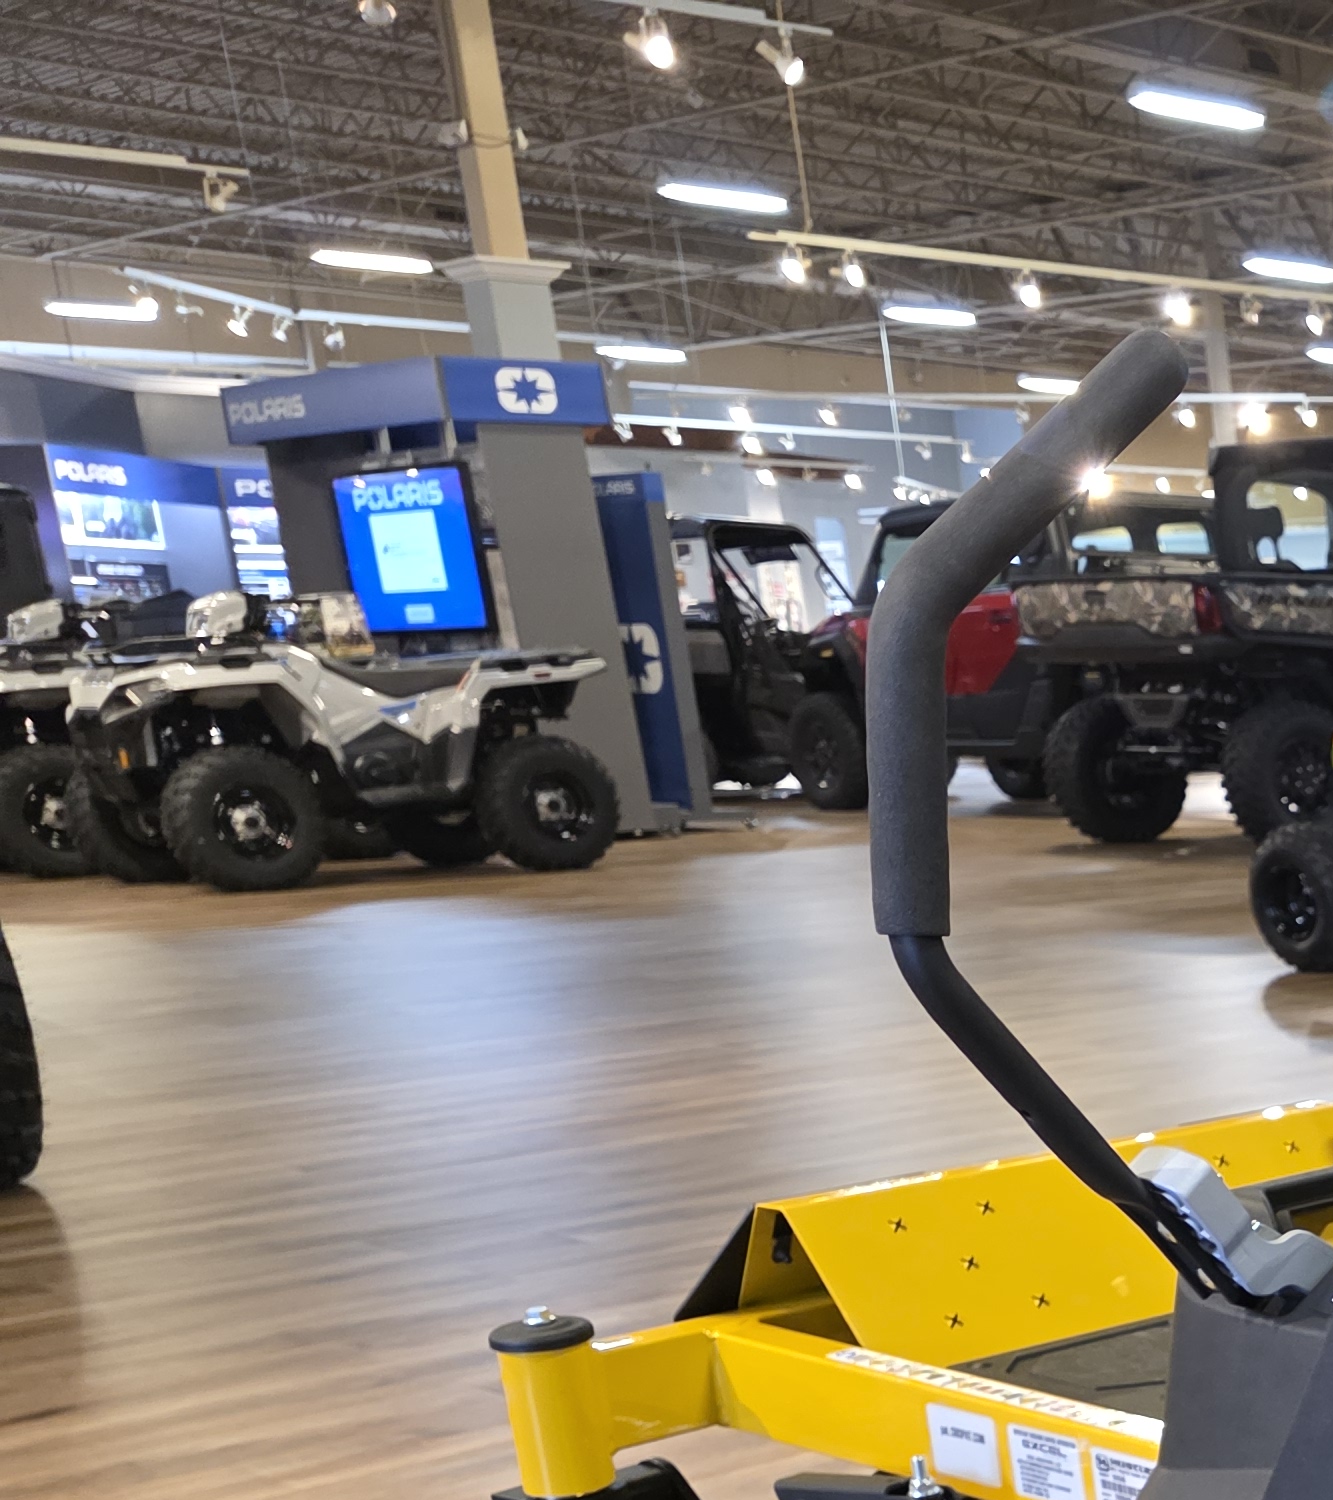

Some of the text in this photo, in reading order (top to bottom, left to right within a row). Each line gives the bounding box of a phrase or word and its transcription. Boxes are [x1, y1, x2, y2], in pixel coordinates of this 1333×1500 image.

[229, 394, 306, 427] POLARIS
[54, 458, 127, 487] POLARIS
[352, 479, 444, 512] POLARIS
